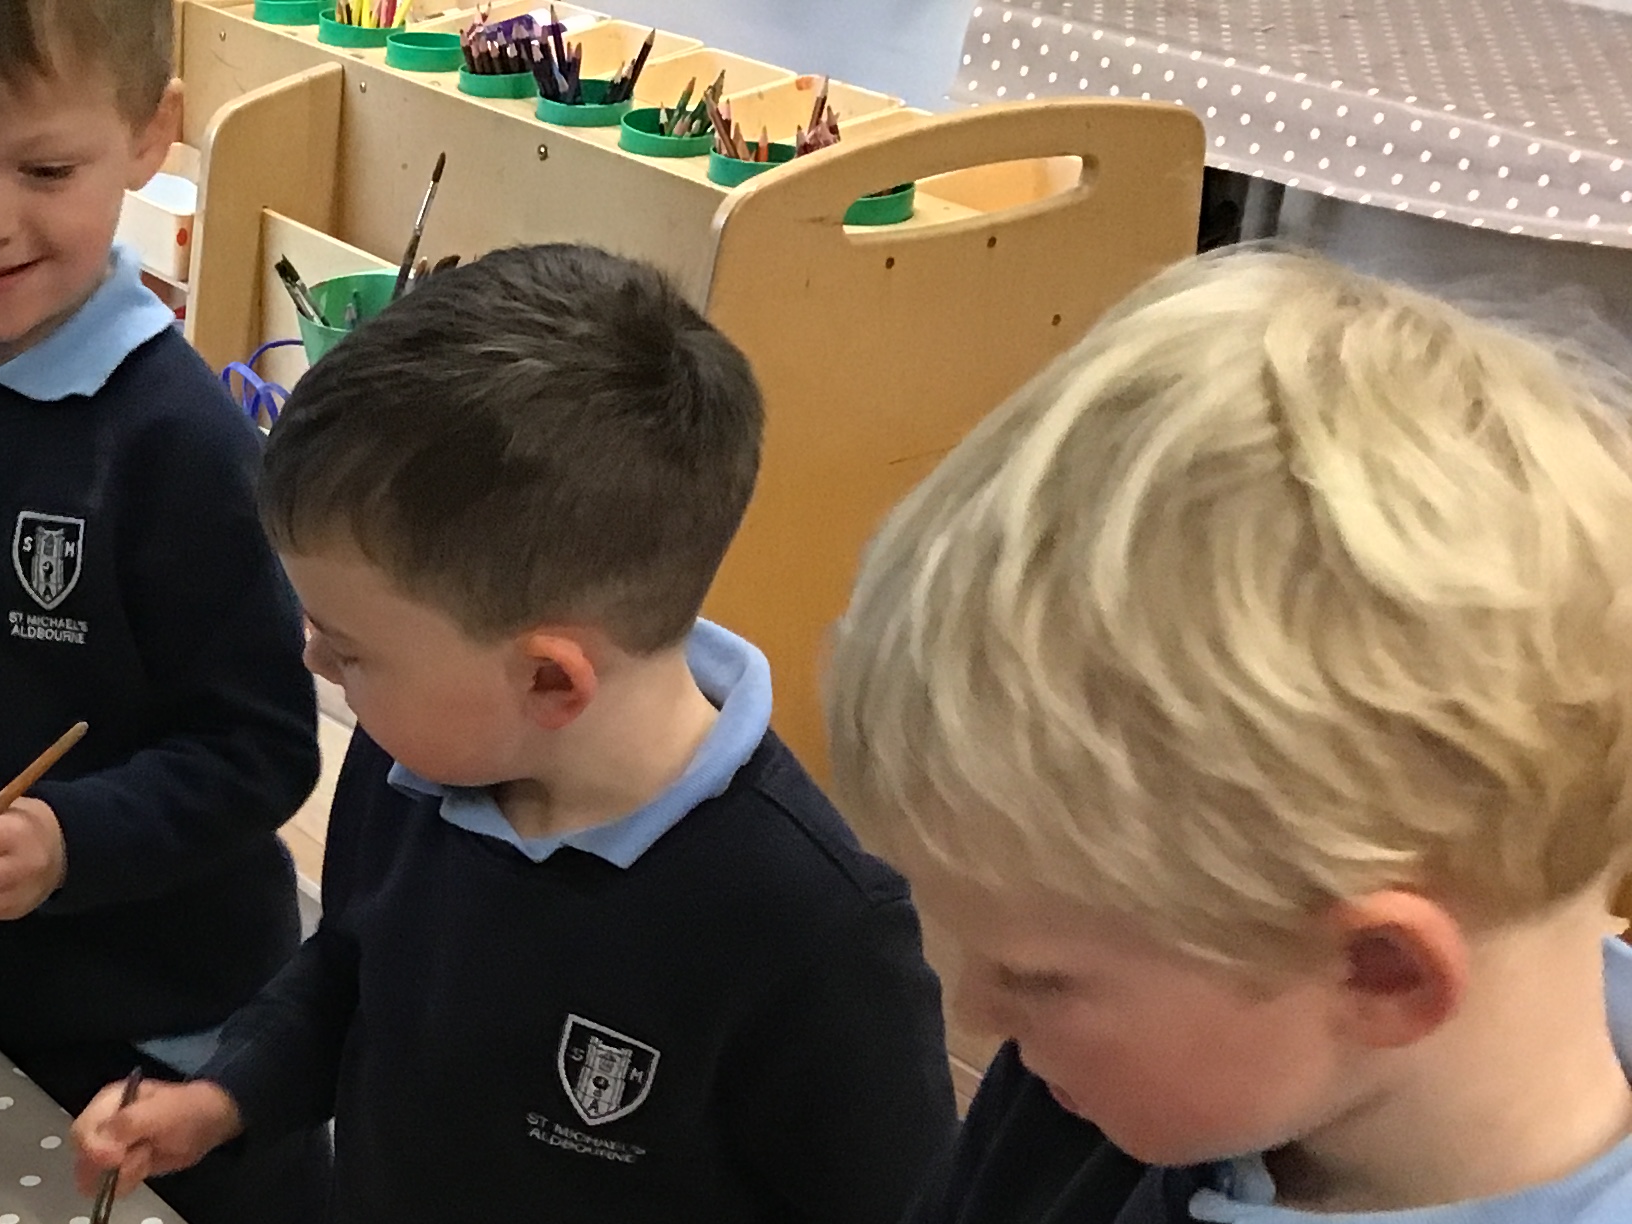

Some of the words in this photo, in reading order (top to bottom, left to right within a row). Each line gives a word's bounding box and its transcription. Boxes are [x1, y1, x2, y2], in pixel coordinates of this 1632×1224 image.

[22, 536, 33, 552] S
[10, 625, 87, 645] ALDBOURNE
[569, 1047, 585, 1062] S
[629, 1067, 644, 1084] M
